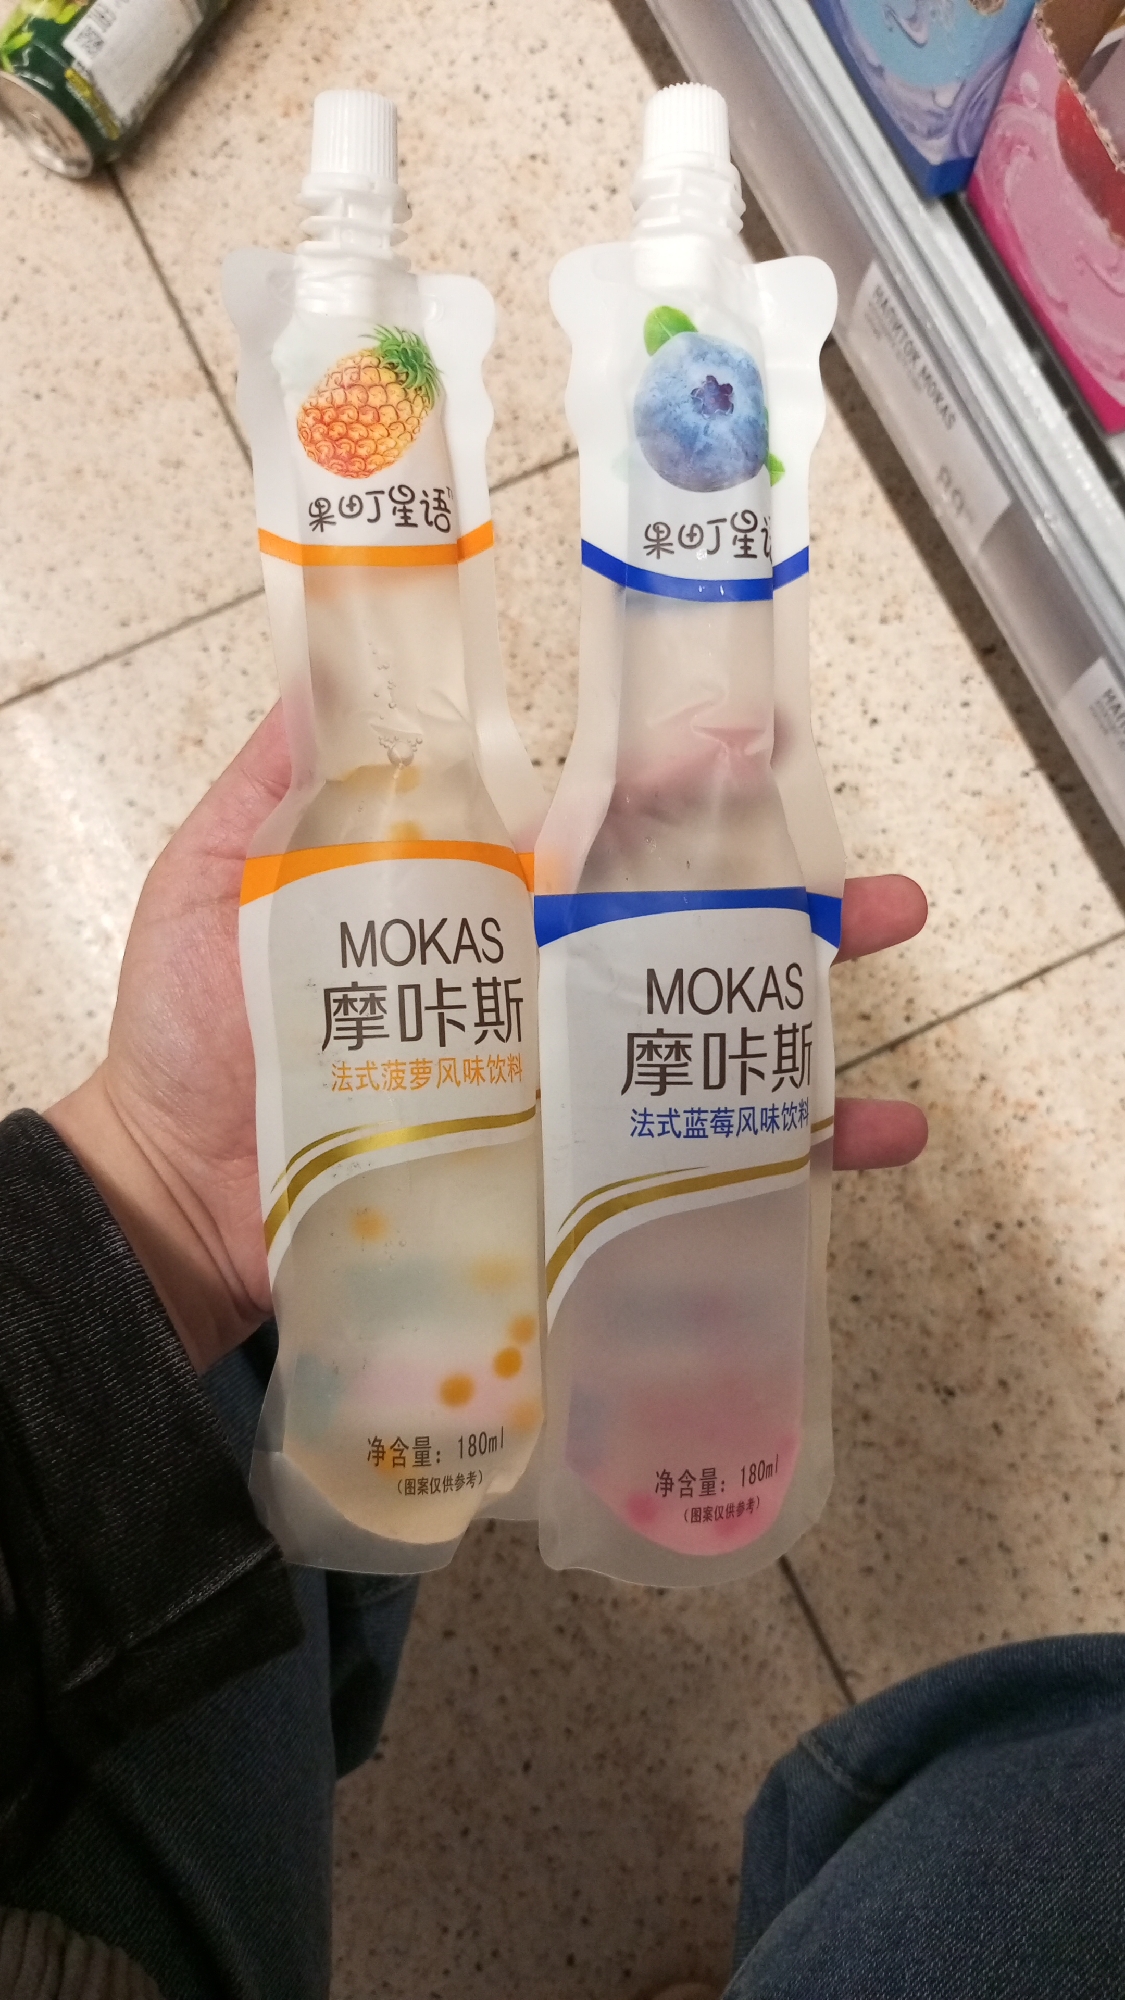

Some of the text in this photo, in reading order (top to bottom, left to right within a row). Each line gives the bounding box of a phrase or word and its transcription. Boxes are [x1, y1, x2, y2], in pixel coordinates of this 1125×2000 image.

[339, 917, 504, 969] MOKAS
[646, 962, 804, 1015] MOKAS
[321, 976, 524, 1051] 摩咔斯
[331, 1052, 523, 1092] 法式菠萝风味饮料
[620, 1021, 813, 1096] 摩咔斯
[630, 1097, 809, 1139] 法式蓝莓风味饮料
[457, 1426, 504, 1460] 180ml
[740, 1453, 779, 1487] 180ml
